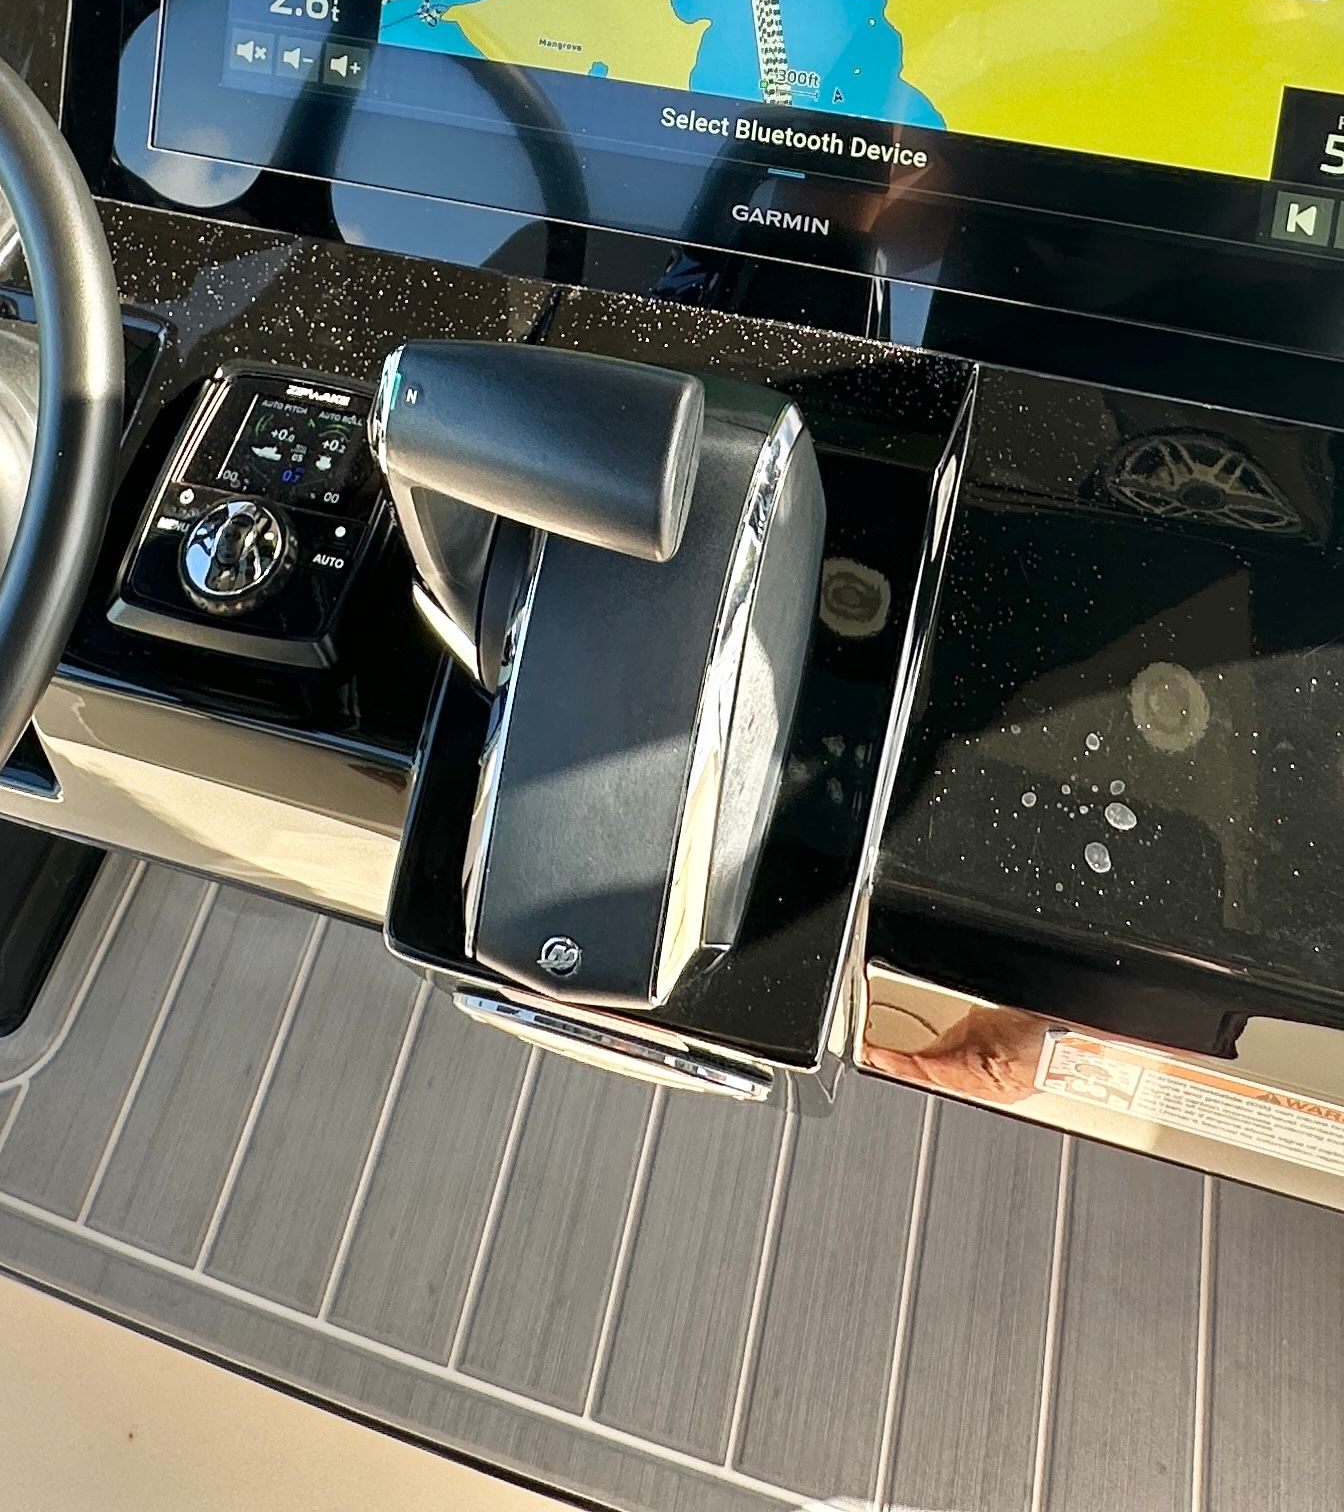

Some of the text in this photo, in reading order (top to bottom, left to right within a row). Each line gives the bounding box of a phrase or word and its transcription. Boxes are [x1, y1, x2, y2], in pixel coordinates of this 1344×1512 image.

[539, 38, 582, 51] Mangrove
[660, 107, 928, 168] Select Bluetooth Device
[731, 204, 830, 235] GARMIN
[405, 388, 418, 404] N
[261, 399, 308, 415] AUTO PITCH
[318, 410, 341, 422] AUTO
[323, 491, 340, 504] 00
[312, 553, 345, 569] AUTO
